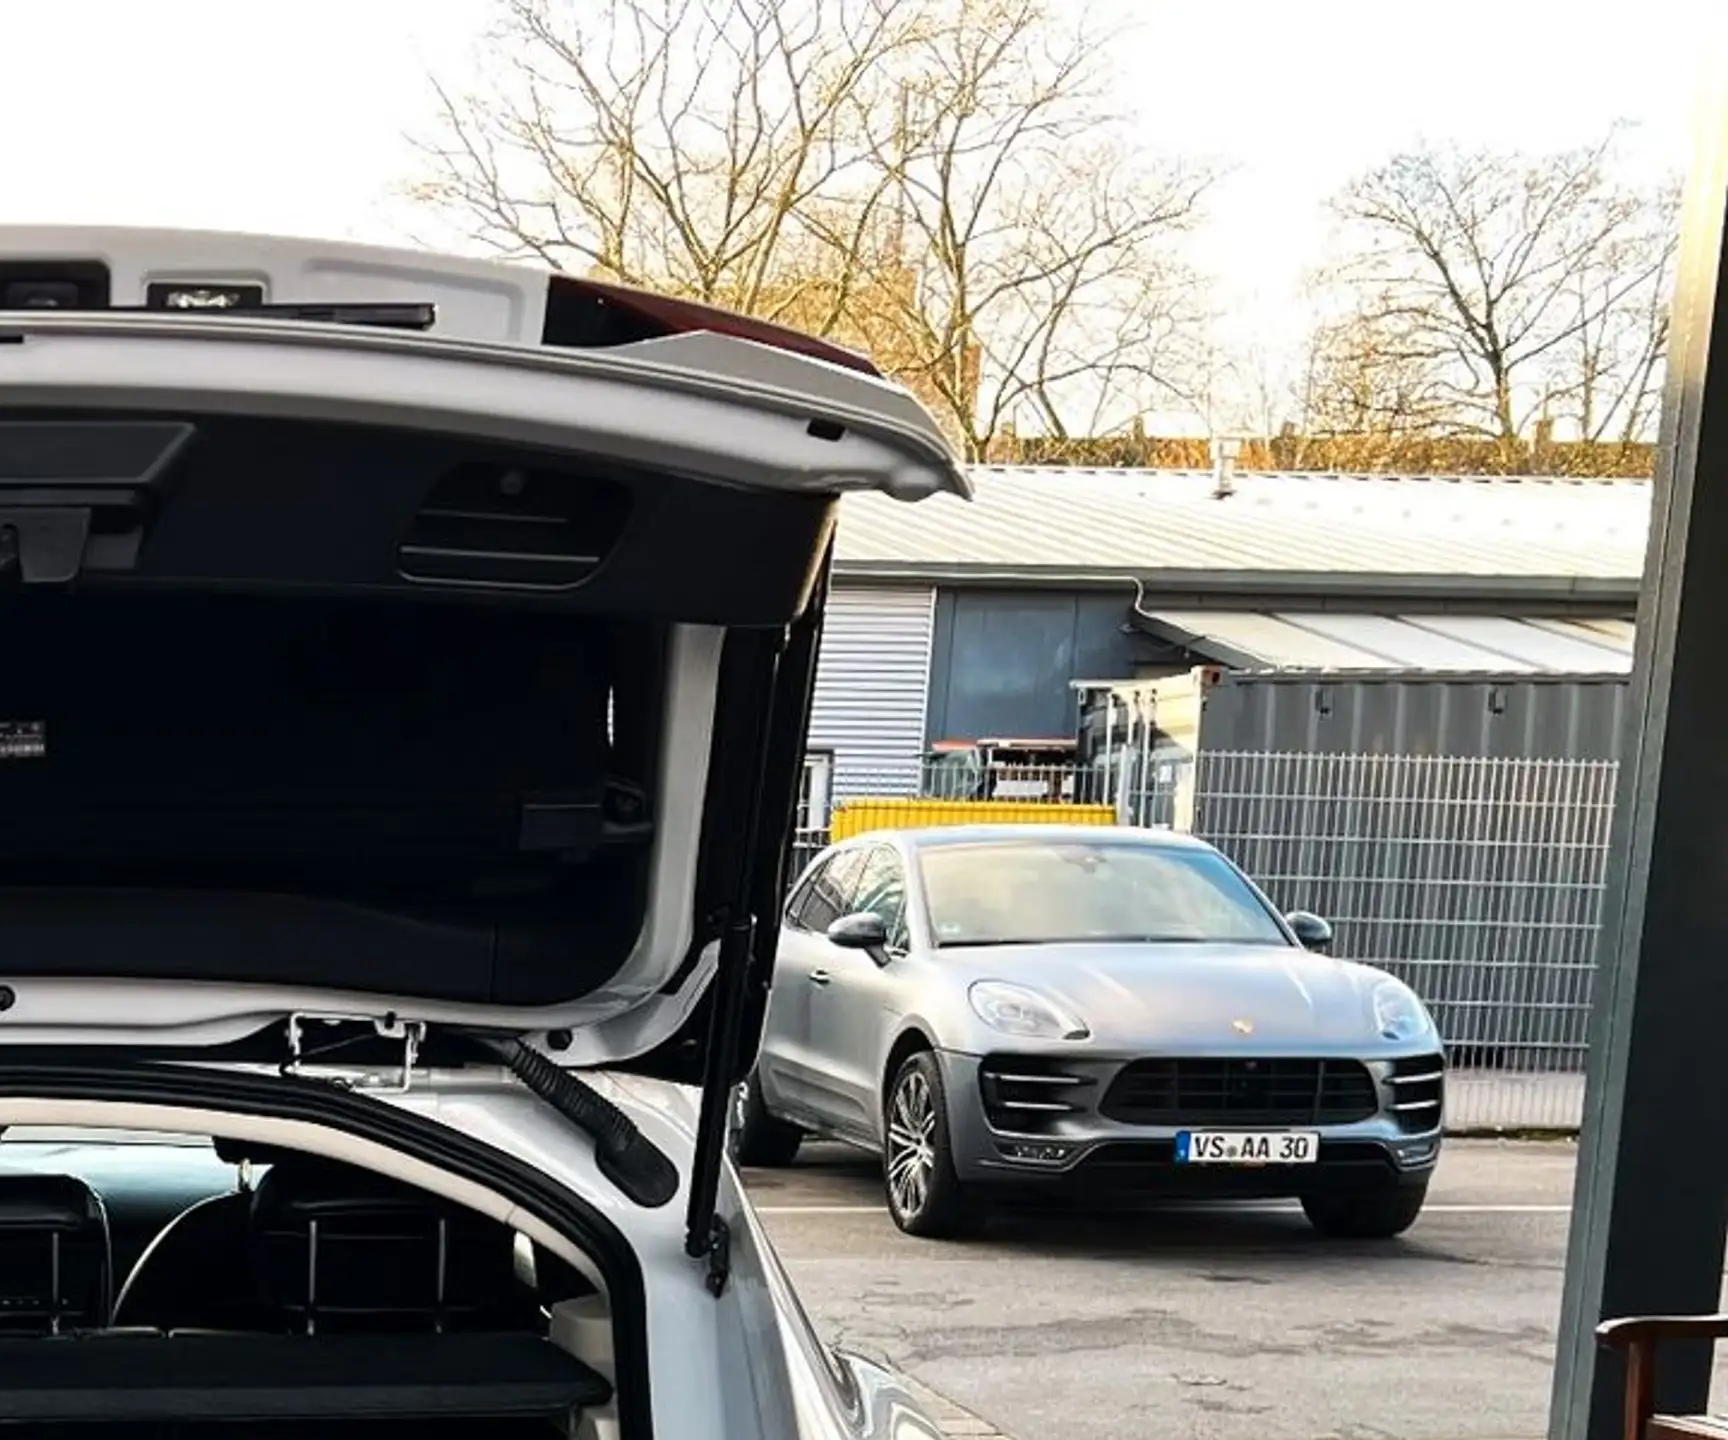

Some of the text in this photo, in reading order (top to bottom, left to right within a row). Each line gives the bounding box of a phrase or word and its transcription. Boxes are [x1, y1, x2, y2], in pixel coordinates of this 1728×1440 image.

[1194, 1136, 1309, 1158] VS AA 30
